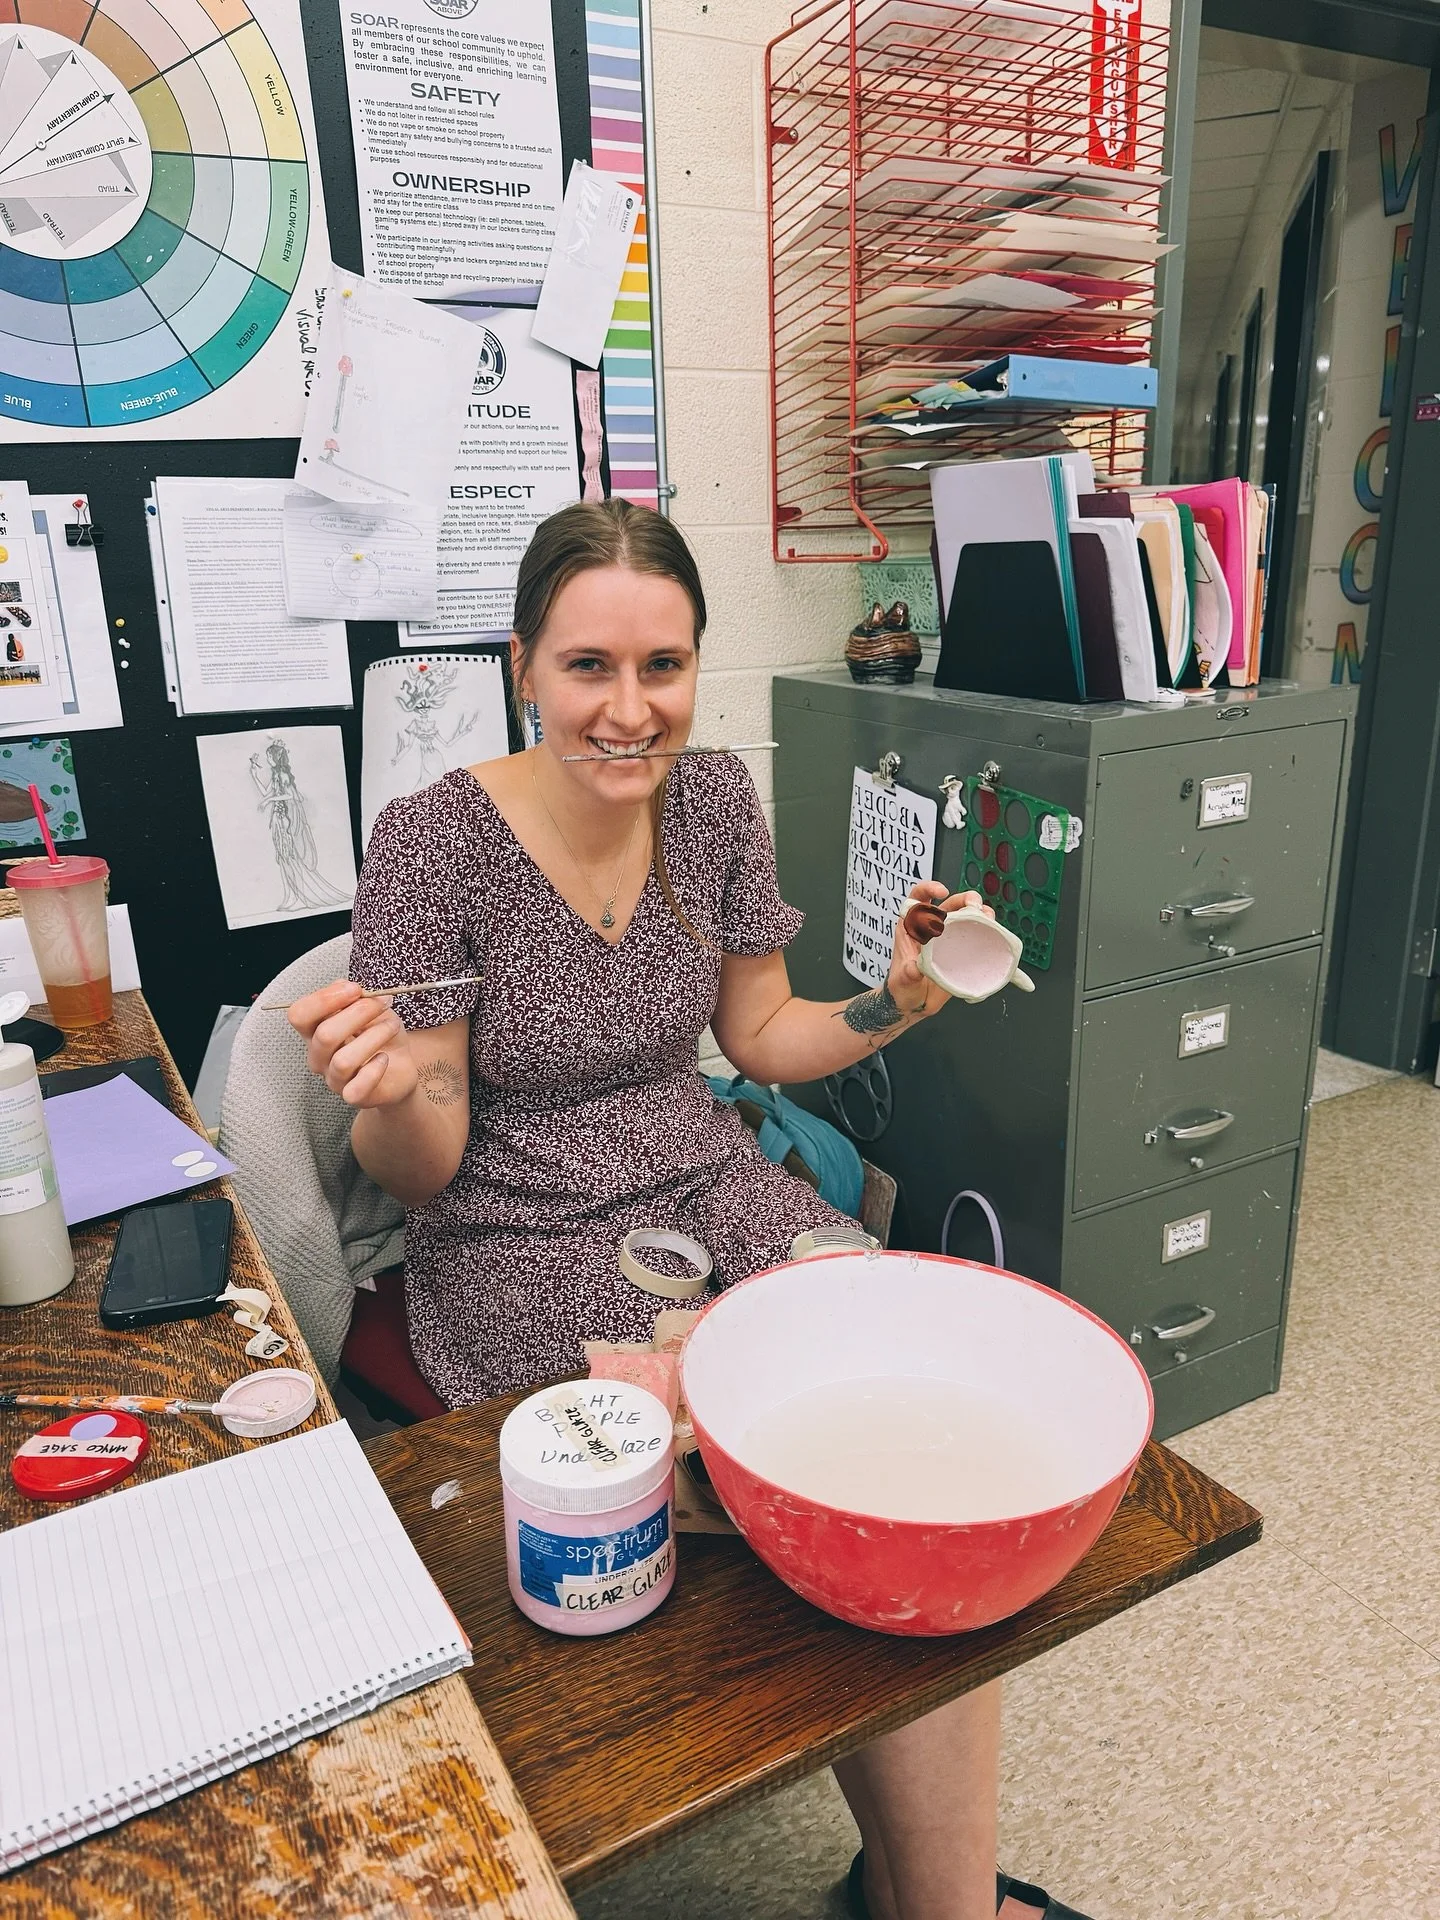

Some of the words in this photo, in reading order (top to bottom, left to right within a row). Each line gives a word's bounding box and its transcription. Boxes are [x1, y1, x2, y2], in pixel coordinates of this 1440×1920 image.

[350, 12, 399, 29] SOAR
[401, 23, 445, 35] represents
[446, 28, 459, 37] the
[461, 31, 479, 40] core
[480, 34, 505, 45] values
[507, 39, 518, 47] we
[519, 41, 545, 51] expect
[351, 27, 362, 36] all
[364, 30, 403, 41] members
[406, 34, 414, 42] of
[432, 38, 460, 48] school
[462, 42, 505, 57] community
[507, 47, 515, 56] to
[517, 50, 545, 61] uphold.
[352, 38, 364, 49] By
[370, 41, 415, 55] embracing
[421, 46, 443, 57] these
[449, 52, 511, 68] responsibilities,
[532, 64, 546, 72] can
[354, 49, 378, 60] foster
[392, 55, 412, 66] safe,
[416, 57, 454, 71] inclusive,
[458, 63, 473, 72] and
[477, 66, 513, 79] enriching
[516, 70, 547, 83] learning
[355, 63, 408, 75] environment
[410, 67, 421, 77] for
[424, 71, 463, 82] everyone.
[264, 73, 285, 116] YELLOW
[410, 82, 501, 107] SAFETY
[46, 90, 100, 131] COMPLEMENTARY
[364, 98, 375, 106] We
[376, 100, 413, 110] understand
[428, 104, 447, 114] follow
[448, 107, 456, 115] all
[457, 108, 478, 117] school
[479, 111, 495, 119] rules
[365, 108, 376, 116] We
[377, 109, 386, 117] do
[399, 111, 416, 120] loiter
[417, 113, 424, 121] in
[425, 115, 455, 124] restricted
[456, 119, 478, 127] spaces
[366, 118, 377, 126] We
[378, 119, 387, 127] do
[400, 123, 416, 131] vape
[425, 125, 446, 133] smoke
[457, 127, 478, 136] school
[479, 131, 505, 140] property
[105, 137, 125, 151] SPLIT
[367, 128, 378, 136] We
[379, 131, 399, 139] report
[400, 133, 412, 141] any
[413, 133, 432, 143] safety
[434, 135, 446, 143] and
[447, 136, 472, 147] bullying
[473, 140, 501, 148] concerns
[502, 141, 509, 149] to
[515, 143, 536, 152] trusted
[537, 145, 552, 154] adult
[46, 144, 105, 167] COMPLEMENTARY
[98, 185, 120, 193] TRIAD
[392, 171, 531, 198] OWNERSHIP
[373, 188, 383, 196] We
[384, 190, 412, 199] prioritize
[414, 192, 450, 203] attendance,
[470, 196, 476, 204] to
[477, 197, 493, 206] class
[495, 200, 520, 209] prepared
[543, 203, 555, 211] time
[387, 198, 400, 207] stay
[412, 199, 422, 207] the
[424, 201, 441, 209] entire
[443, 202, 459, 210] class
[42, 212, 66, 241] TETRAD
[282, 188, 297, 264] YELLOW-GREEN
[236, 322, 259, 349] GREEN
[4, 394, 32, 409] BLUE
[120, 386, 178, 412] BLUE-GREEN
[467, 404, 531, 419] ITUDE
[481, 423, 504, 431] actions,
[516, 423, 539, 432] learning
[482, 439, 508, 448] positivity
[526, 440, 546, 448] growth
[483, 464, 516, 472] respectfully
[449, 485, 536, 499] ESPECT
[461, 503, 473, 511] they
[39, 1444, 79, 1454] SAGE
[86, 1444, 128, 1454] MAYCO
[541, 1437, 661, 1464] Undlaze
[566, 1518, 662, 1563] spectrum
[566, 1585, 625, 1611] CLEAR
[632, 1547, 672, 1597] GLAZE
